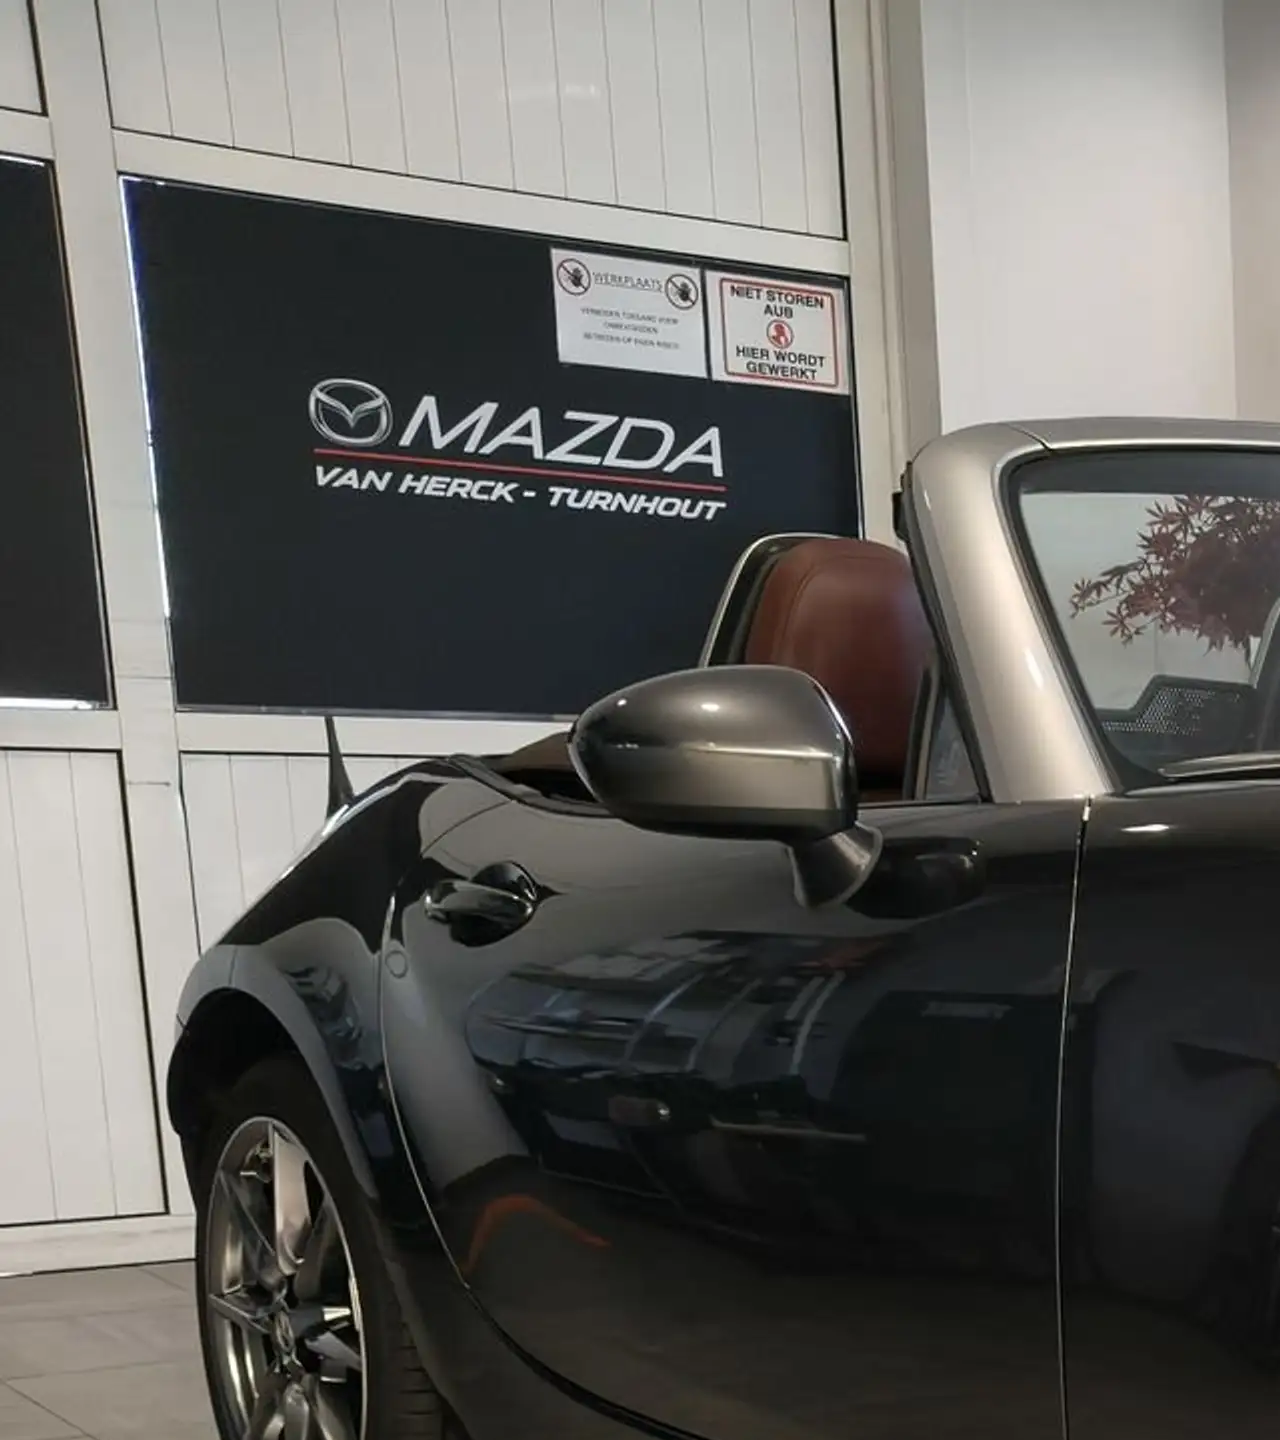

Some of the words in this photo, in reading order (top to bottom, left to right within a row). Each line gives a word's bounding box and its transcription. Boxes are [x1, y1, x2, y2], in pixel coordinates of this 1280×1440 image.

[730, 284, 762, 300] NIET
[766, 289, 825, 309] STOREN
[764, 303, 794, 319] AUB
[736, 345, 769, 360] HIER
[773, 349, 826, 368] WORDT
[746, 360, 818, 380] GEWERKT
[399, 395, 725, 477] MAZDA
[314, 465, 393, 492] VAN
[398, 473, 519, 502] HERCK
[548, 486, 728, 521] TURNHOUT
